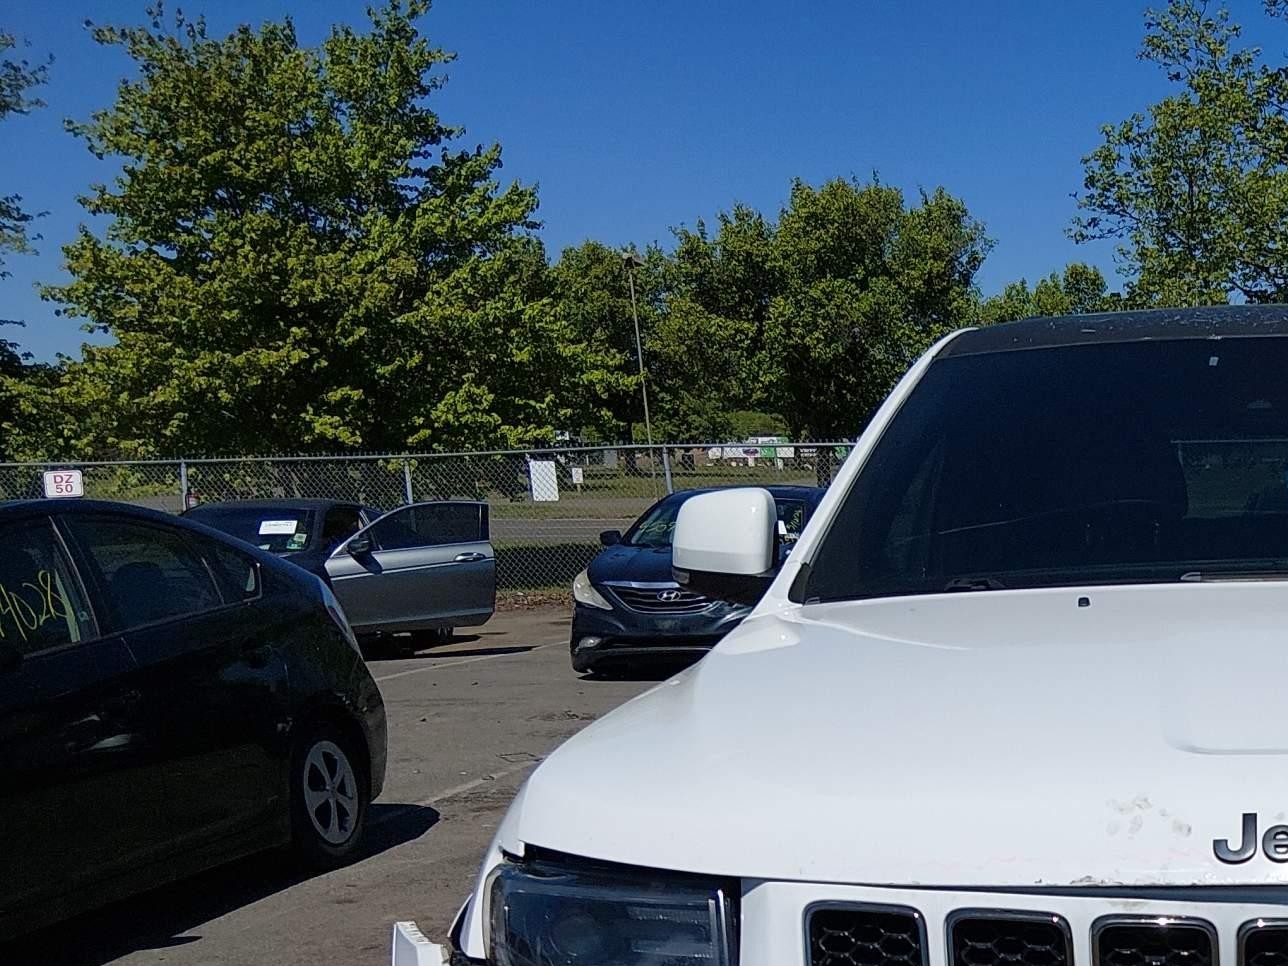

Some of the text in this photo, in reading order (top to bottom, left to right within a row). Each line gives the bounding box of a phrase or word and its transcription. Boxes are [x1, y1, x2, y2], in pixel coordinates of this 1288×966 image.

[53, 474, 74, 484] DZ
[55, 483, 73, 494] 50
[0, 569, 69, 641] 4028
